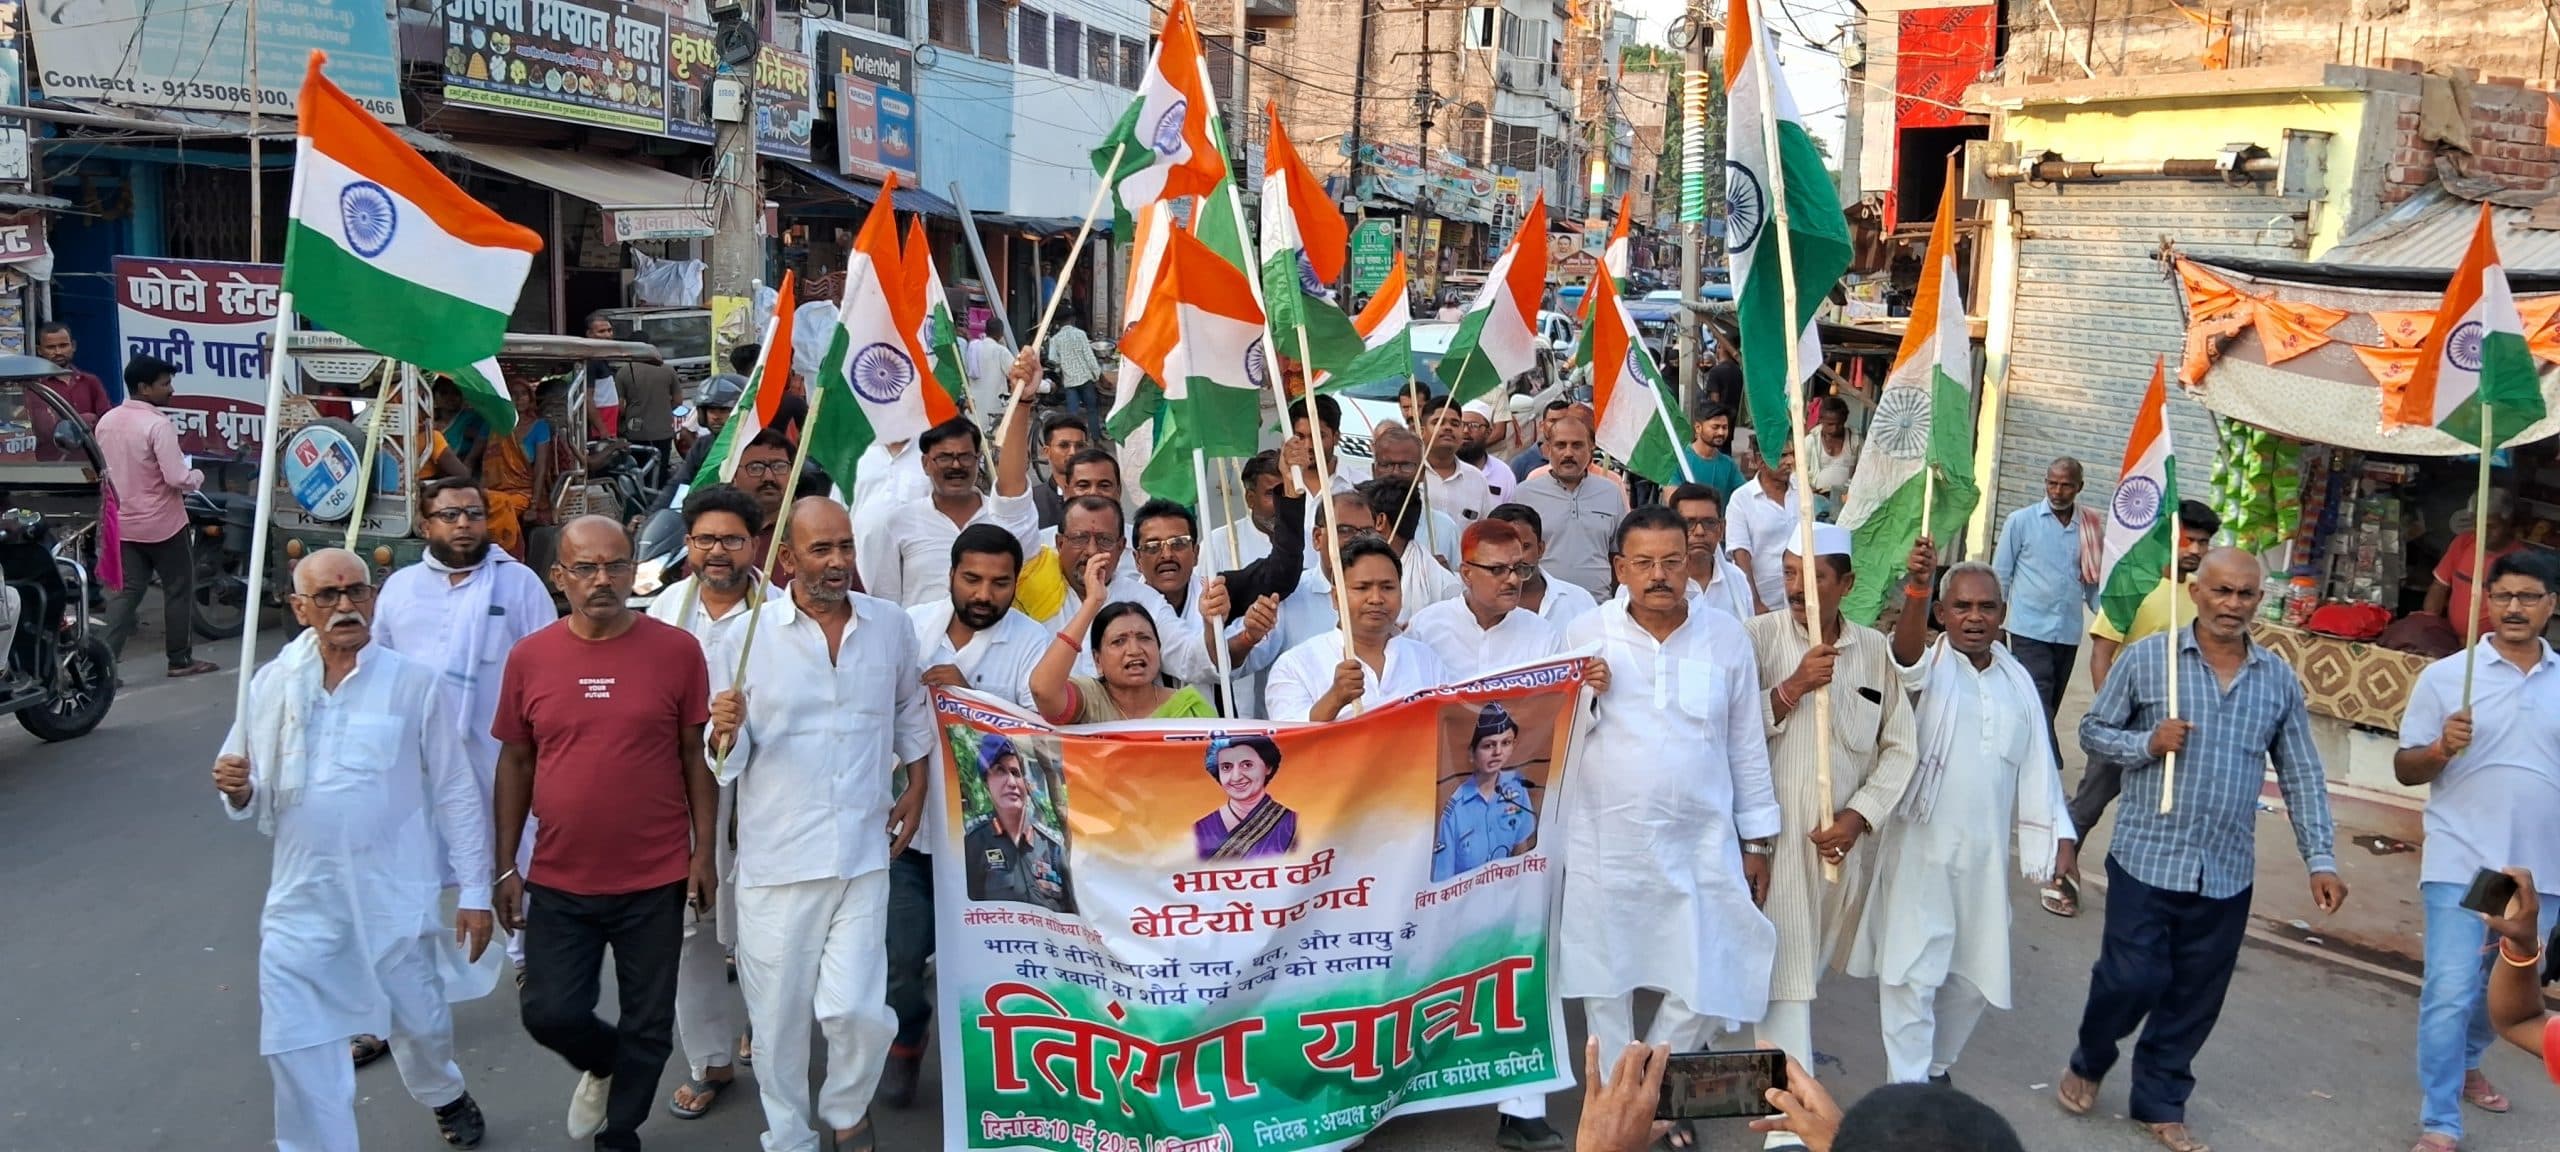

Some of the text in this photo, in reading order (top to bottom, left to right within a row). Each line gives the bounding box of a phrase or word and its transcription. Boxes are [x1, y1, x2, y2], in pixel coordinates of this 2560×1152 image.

[614, 4, 662, 64] भंडार
[45, 70, 136, 94] Contact
[854, 53, 900, 81] orientbell
[128, 267, 280, 316] फोटो स्टेट
[1173, 849, 1335, 893] भारत की
[1415, 853, 1547, 909] विंग कमांडर व्योमिका सिंह
[1130, 877, 1375, 937] बेटियों पर गर्व
[985, 922, 1418, 979] भारत के तीनों सेनाओं जल, थल, और वायु के
[1016, 959, 1048, 979] वीर
[1054, 967, 1107, 991] जवानों
[1112, 979, 1132, 1000] का
[1140, 982, 1189, 1004] शौर्य
[1197, 980, 1230, 1005] एवं
[1285, 956, 1317, 976] को
[1326, 953, 1393, 971] सलाम
[978, 956, 1534, 1116] तिरंगा यात्रा
[1253, 1117, 1309, 1147] निवेदक
[1442, 1054, 1491, 1085] कांग्रेस
[1495, 1047, 1545, 1077] कमिटी
[1073, 1119, 1096, 1149] मई
